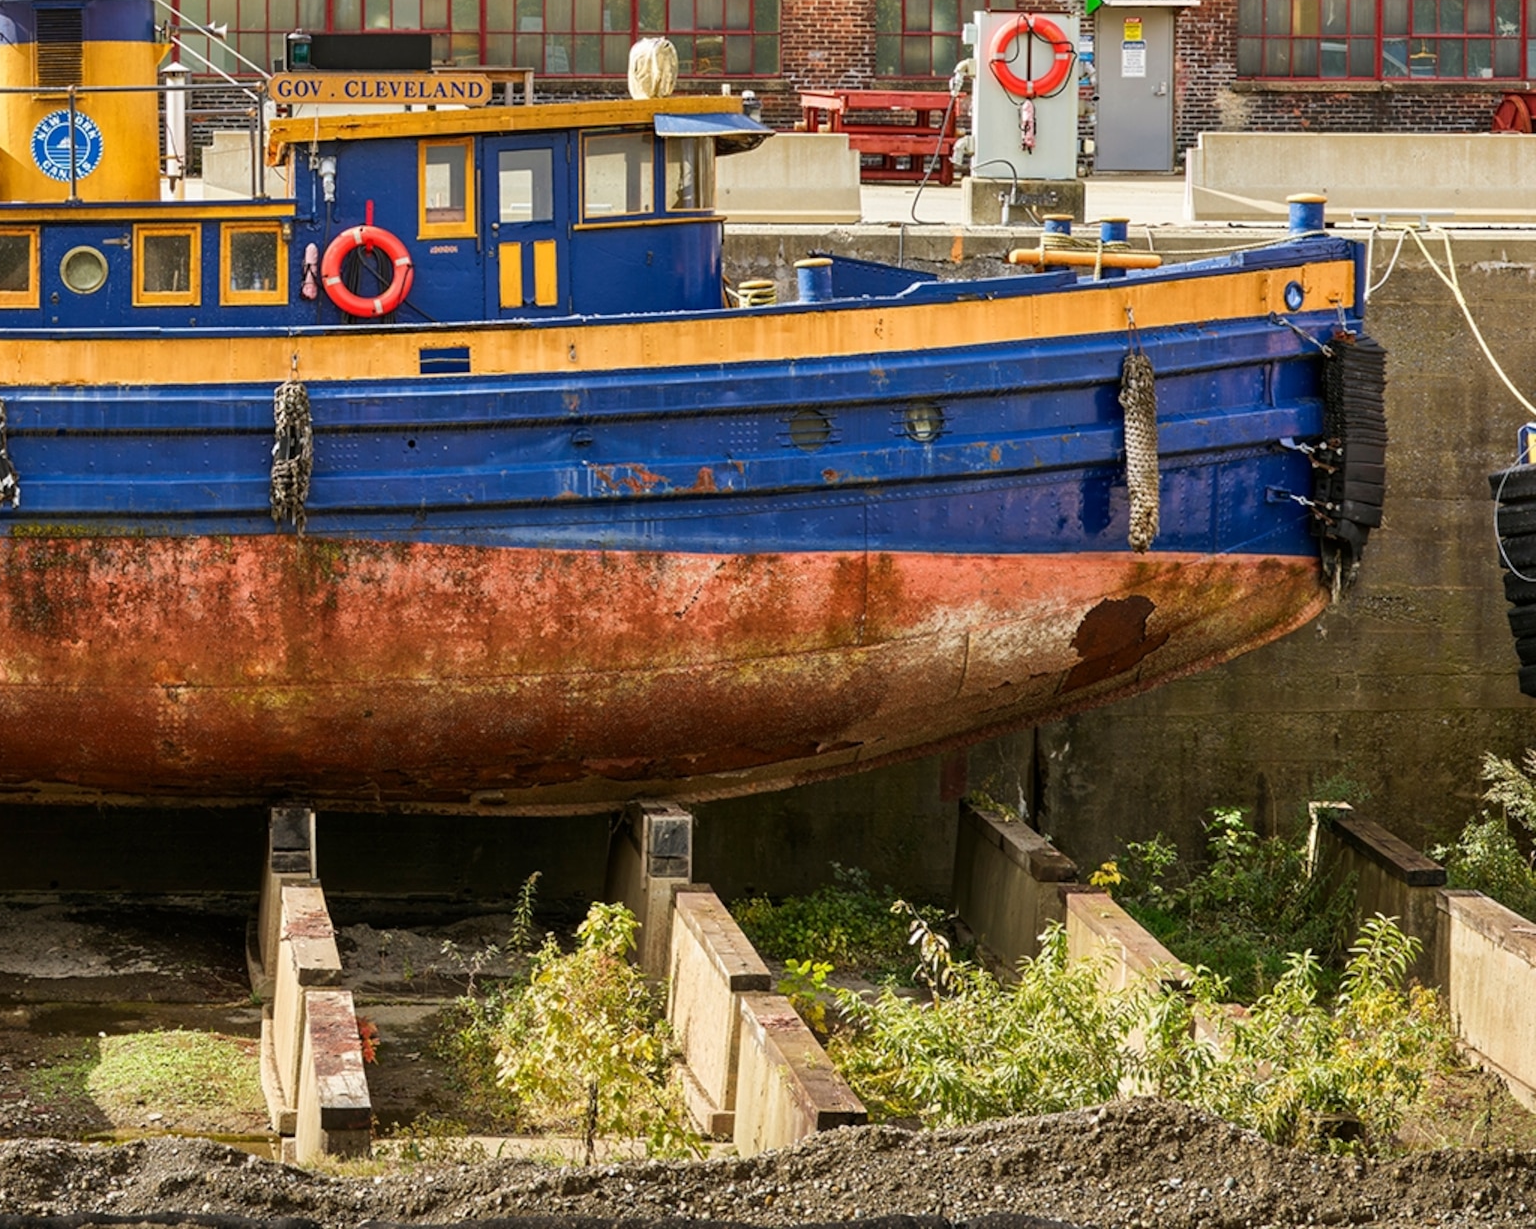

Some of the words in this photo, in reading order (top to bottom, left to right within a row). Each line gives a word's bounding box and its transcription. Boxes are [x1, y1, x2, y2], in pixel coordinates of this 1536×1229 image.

[344, 80, 484, 99] CLEVELAND
[36, 116, 61, 141] NEW
[68, 113, 98, 140] ORK
[42, 160, 92, 180] CANLS
